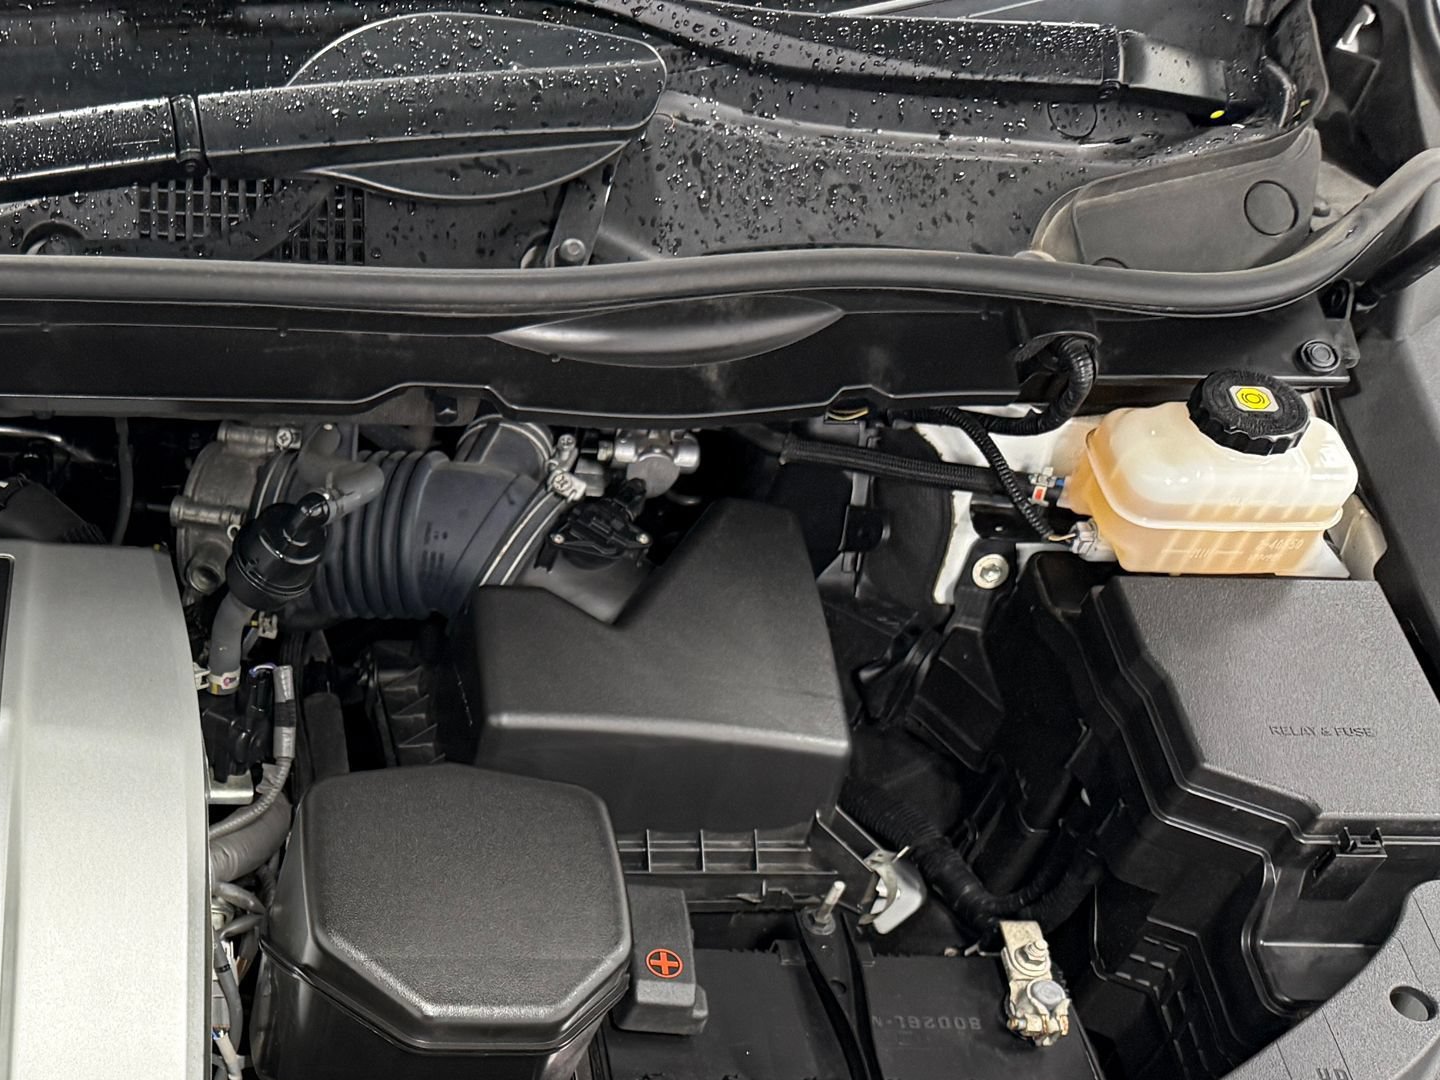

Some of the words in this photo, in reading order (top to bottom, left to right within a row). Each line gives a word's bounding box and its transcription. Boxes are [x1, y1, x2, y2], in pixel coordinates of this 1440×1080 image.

[1268, 726, 1317, 737] RELAY
[1321, 727, 1332, 737] &
[1334, 727, 1376, 738] FUSE
